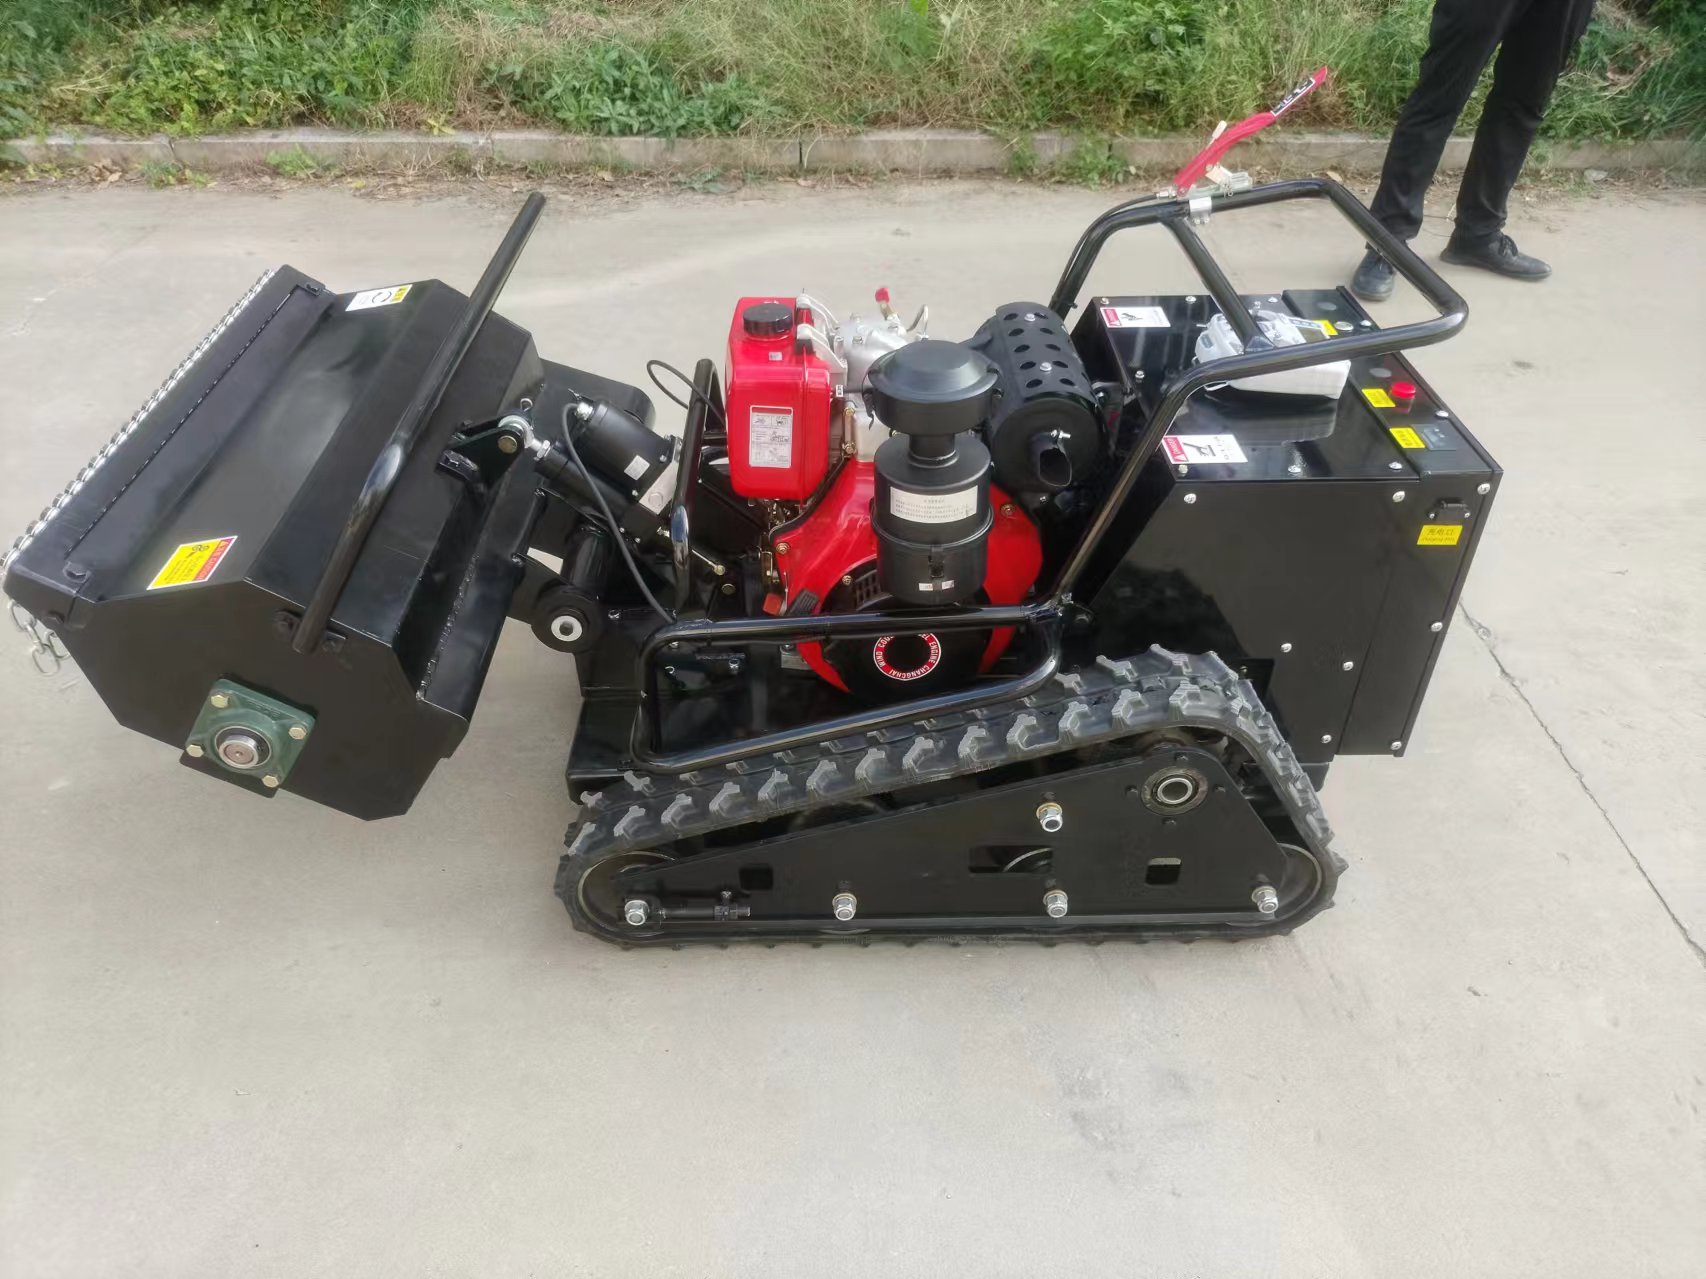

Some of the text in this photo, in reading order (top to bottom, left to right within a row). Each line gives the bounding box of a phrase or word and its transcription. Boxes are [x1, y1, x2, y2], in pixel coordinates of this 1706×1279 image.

[876, 651, 886, 667] WIND
[929, 641, 938, 664] ENGINE
[889, 664, 930, 679] CHANGCHAI
